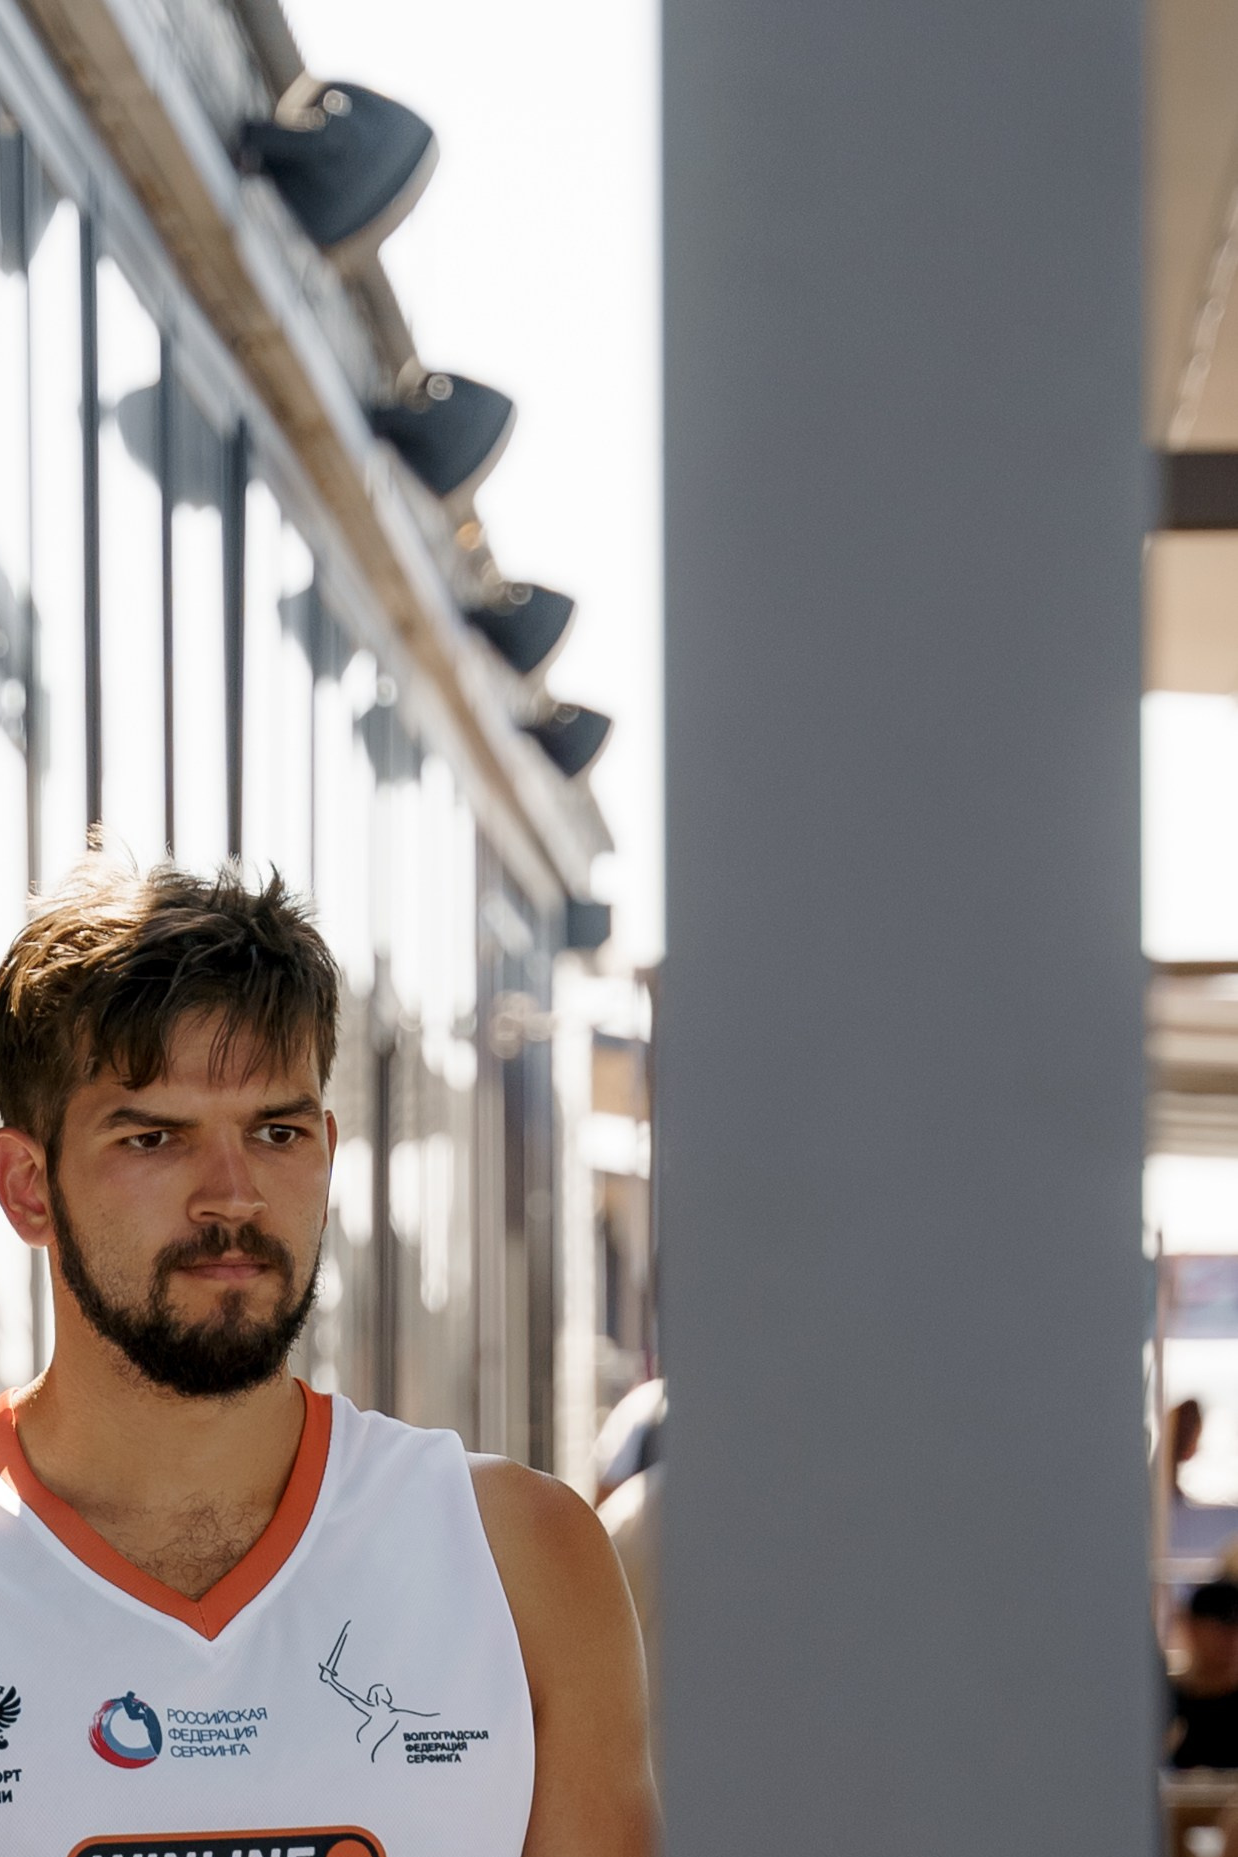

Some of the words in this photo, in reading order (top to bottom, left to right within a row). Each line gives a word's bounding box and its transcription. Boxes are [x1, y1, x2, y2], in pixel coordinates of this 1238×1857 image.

[167, 1707, 267, 1725] РОССИЙСКАЯ
[168, 1725, 257, 1743] ФЕДЕРАЦИЯ
[403, 1731, 489, 1742] ВОЛГОГРАДСКАЯ
[170, 1743, 250, 1757] СЕРФИНГА
[405, 1742, 468, 1753] ФЕДЕРАЦИЯ
[407, 1753, 461, 1763] СЕРФИНГА
